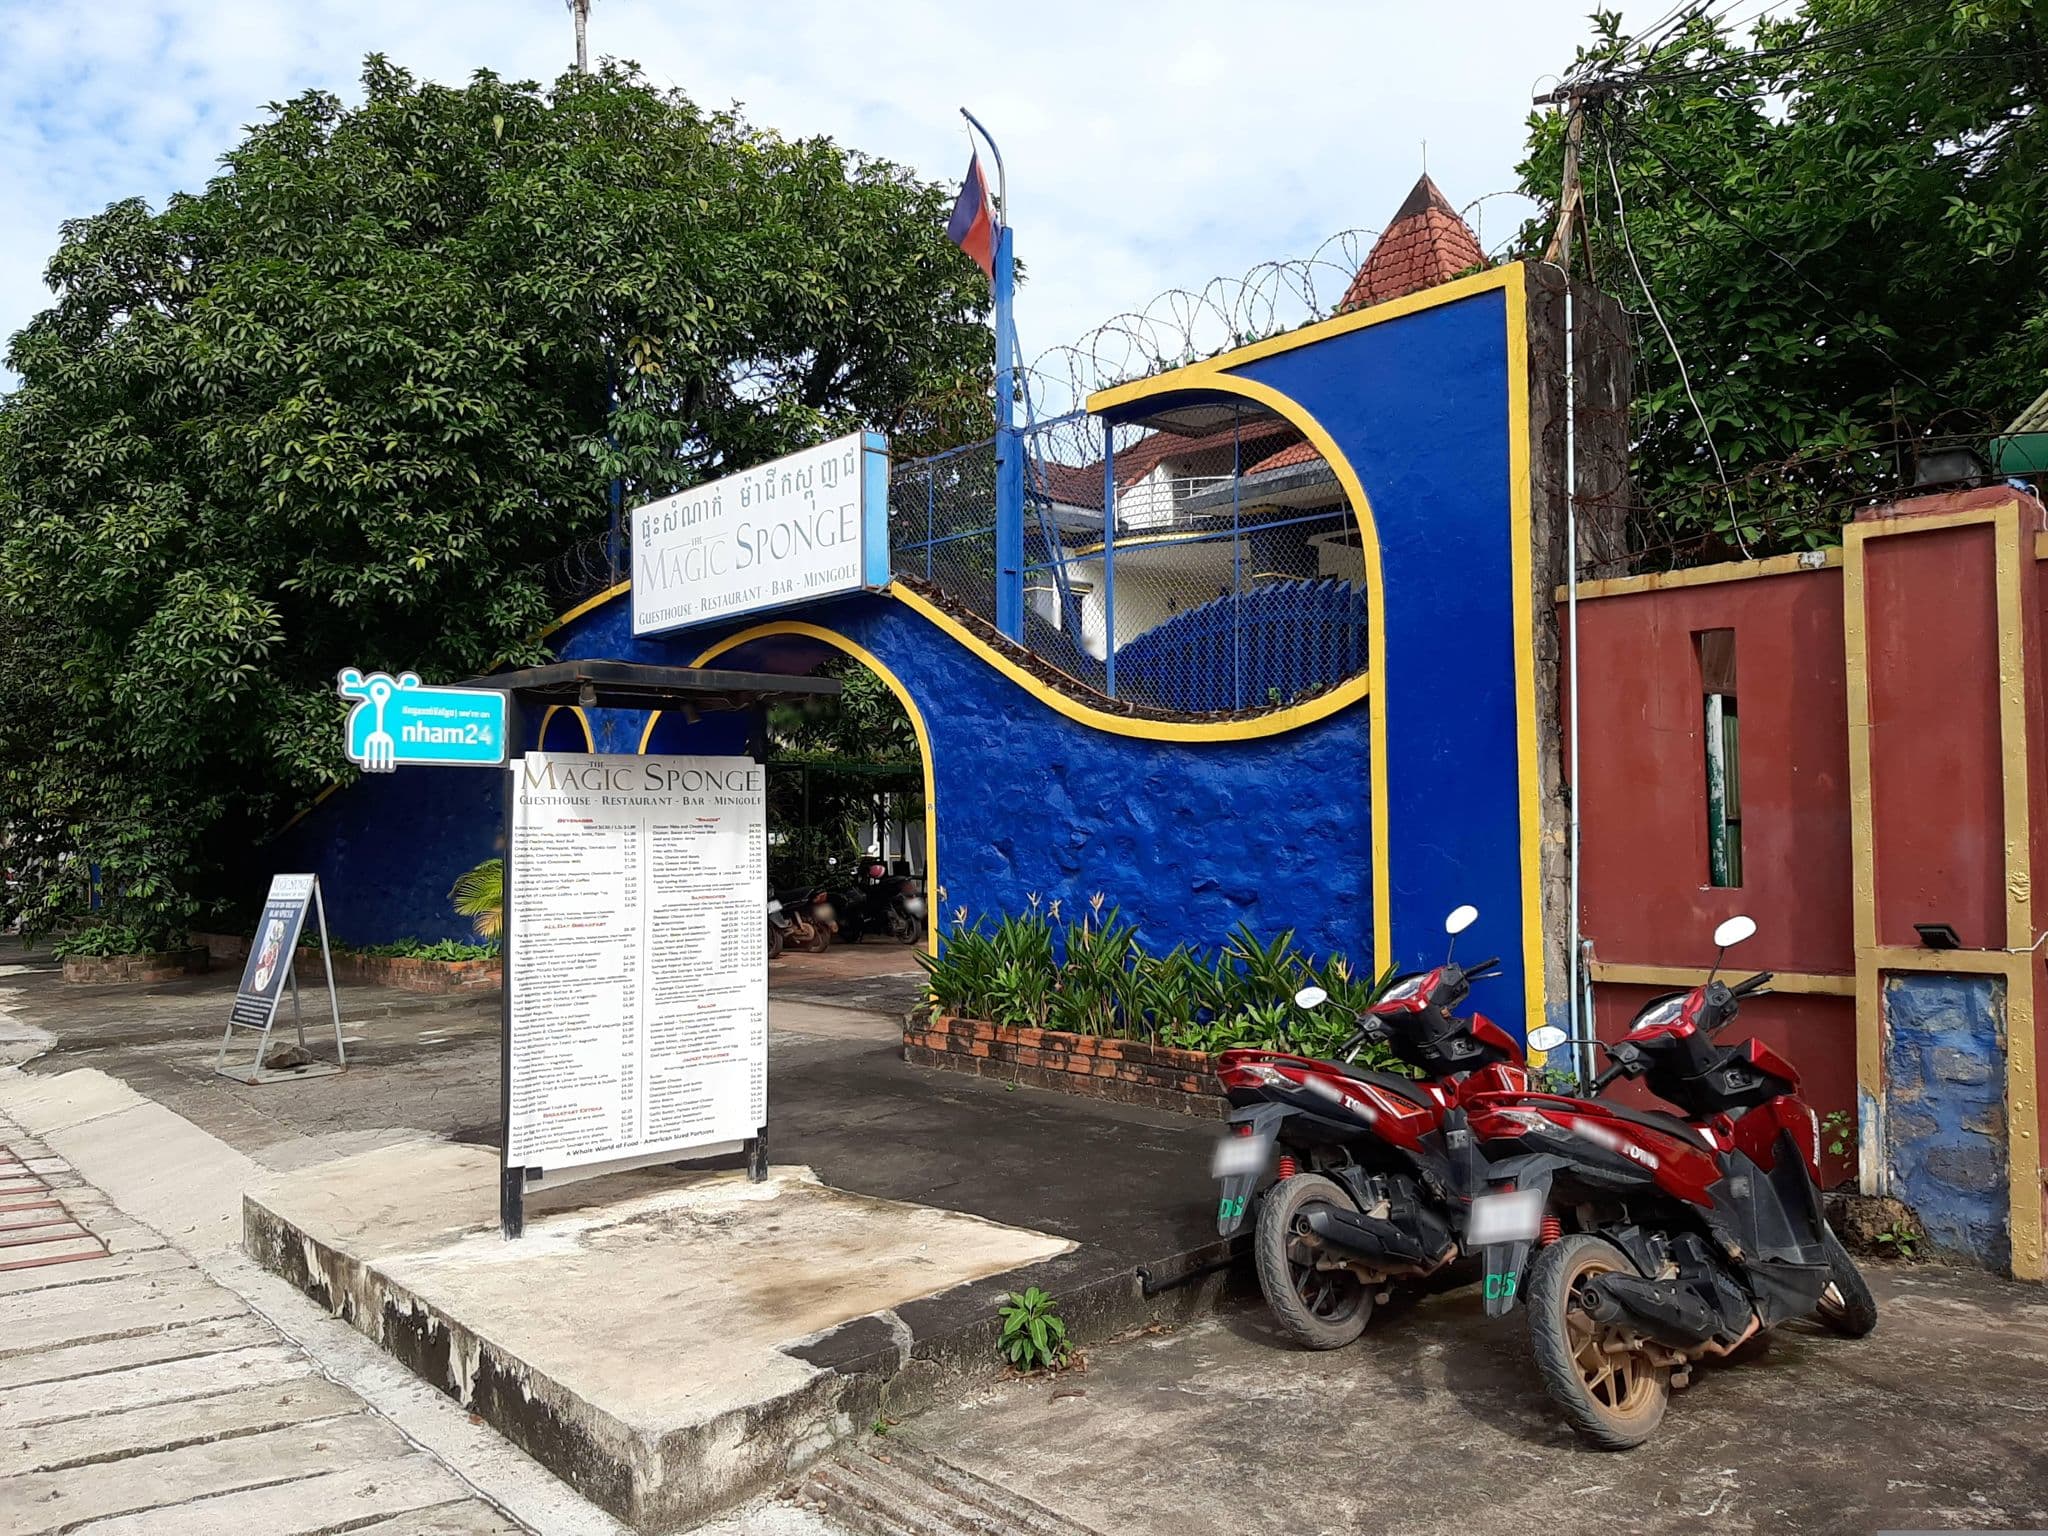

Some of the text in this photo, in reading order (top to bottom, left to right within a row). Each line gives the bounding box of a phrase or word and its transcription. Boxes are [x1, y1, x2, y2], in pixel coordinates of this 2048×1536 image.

[640, 503, 857, 595] MAGIC SPONGE
[690, 537, 703, 547] THE
[638, 602, 692, 626] GUESTHOUSE
[700, 587, 761, 611] RESTAURANT
[771, 580, 793, 596] BAR
[803, 563, 858, 588] MINIGOLF
[402, 720, 494, 745] nham24
[521, 761, 762, 791] MAGIC SPONGE
[519, 795, 591, 806] GUESTHOUSE
[602, 795, 673, 806] RESTAURANT
[683, 796, 705, 805] BAR
[573, 1148, 594, 1156] Whole
[595, 1144, 614, 1152] World
